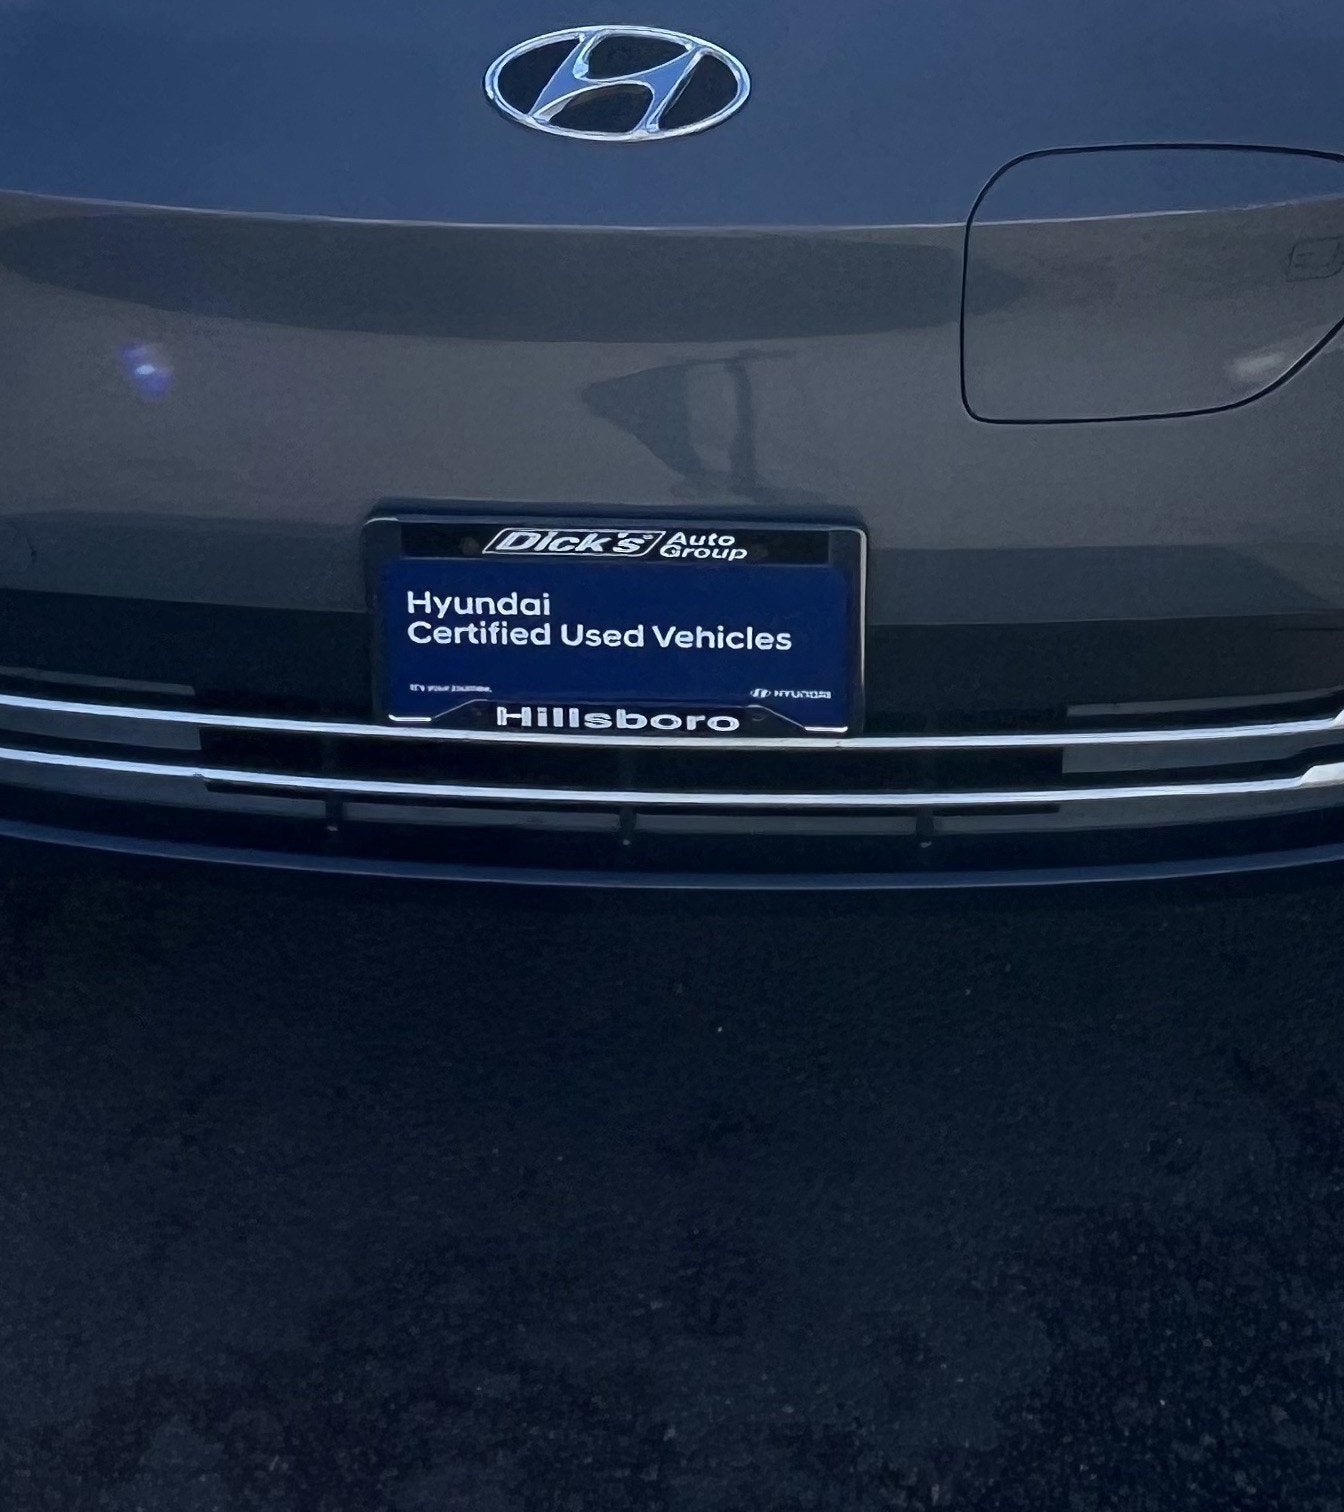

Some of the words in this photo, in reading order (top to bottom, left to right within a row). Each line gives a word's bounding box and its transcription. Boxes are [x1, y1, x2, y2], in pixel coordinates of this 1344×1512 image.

[666, 532, 735, 546] Auto
[660, 544, 748, 561] Group
[407, 591, 551, 617] Hyundai
[407, 620, 551, 646] Certified
[560, 624, 645, 648] Used
[651, 625, 792, 651] Vehicles
[496, 706, 740, 732] Hillsboro
